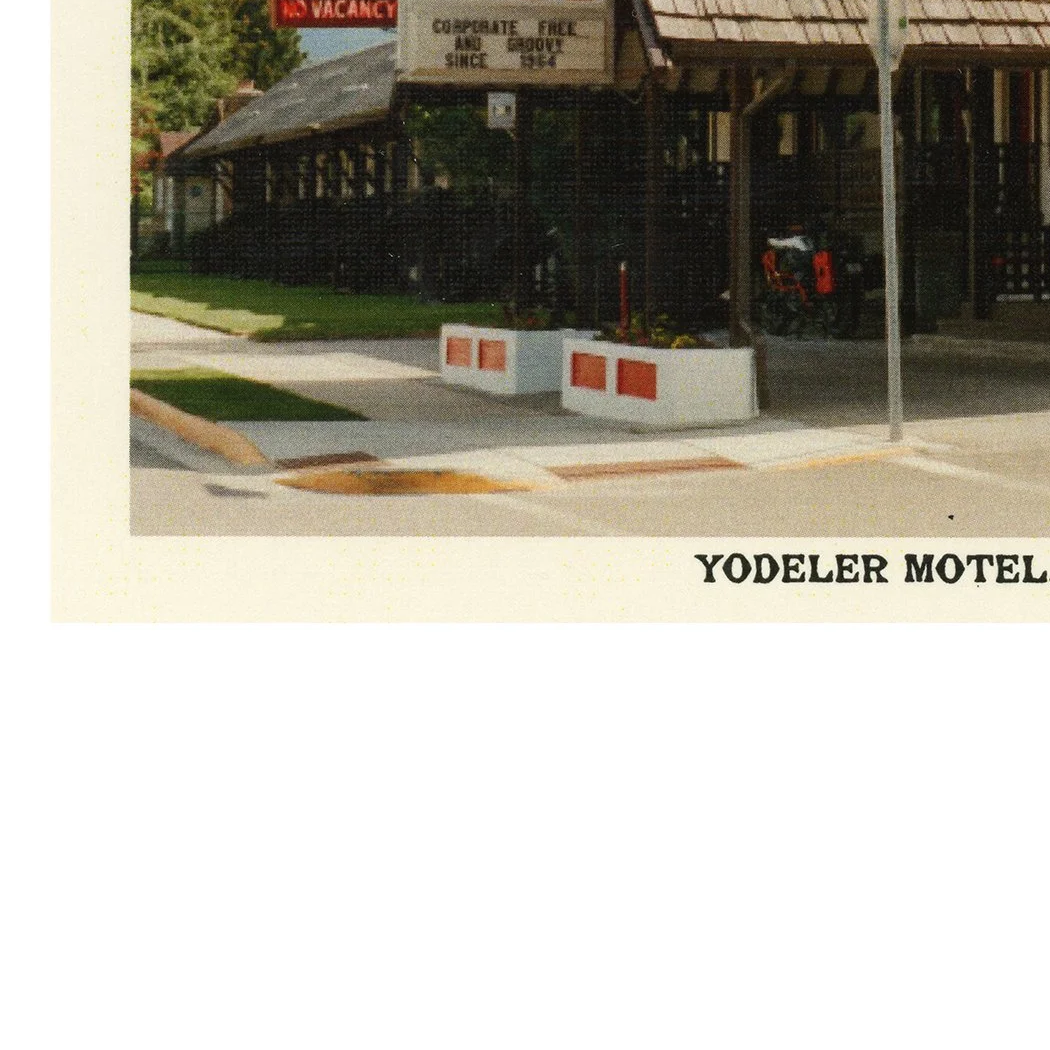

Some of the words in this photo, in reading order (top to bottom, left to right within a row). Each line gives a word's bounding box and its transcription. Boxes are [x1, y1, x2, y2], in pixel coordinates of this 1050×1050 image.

[283, 0, 307, 18] NO
[312, 0, 398, 19] VACANCY
[432, 18, 519, 35] CORPORATE
[538, 20, 577, 36] FREE
[455, 36, 482, 51] AND
[507, 37, 564, 53] GROOVY
[445, 52, 487, 68] SINCE
